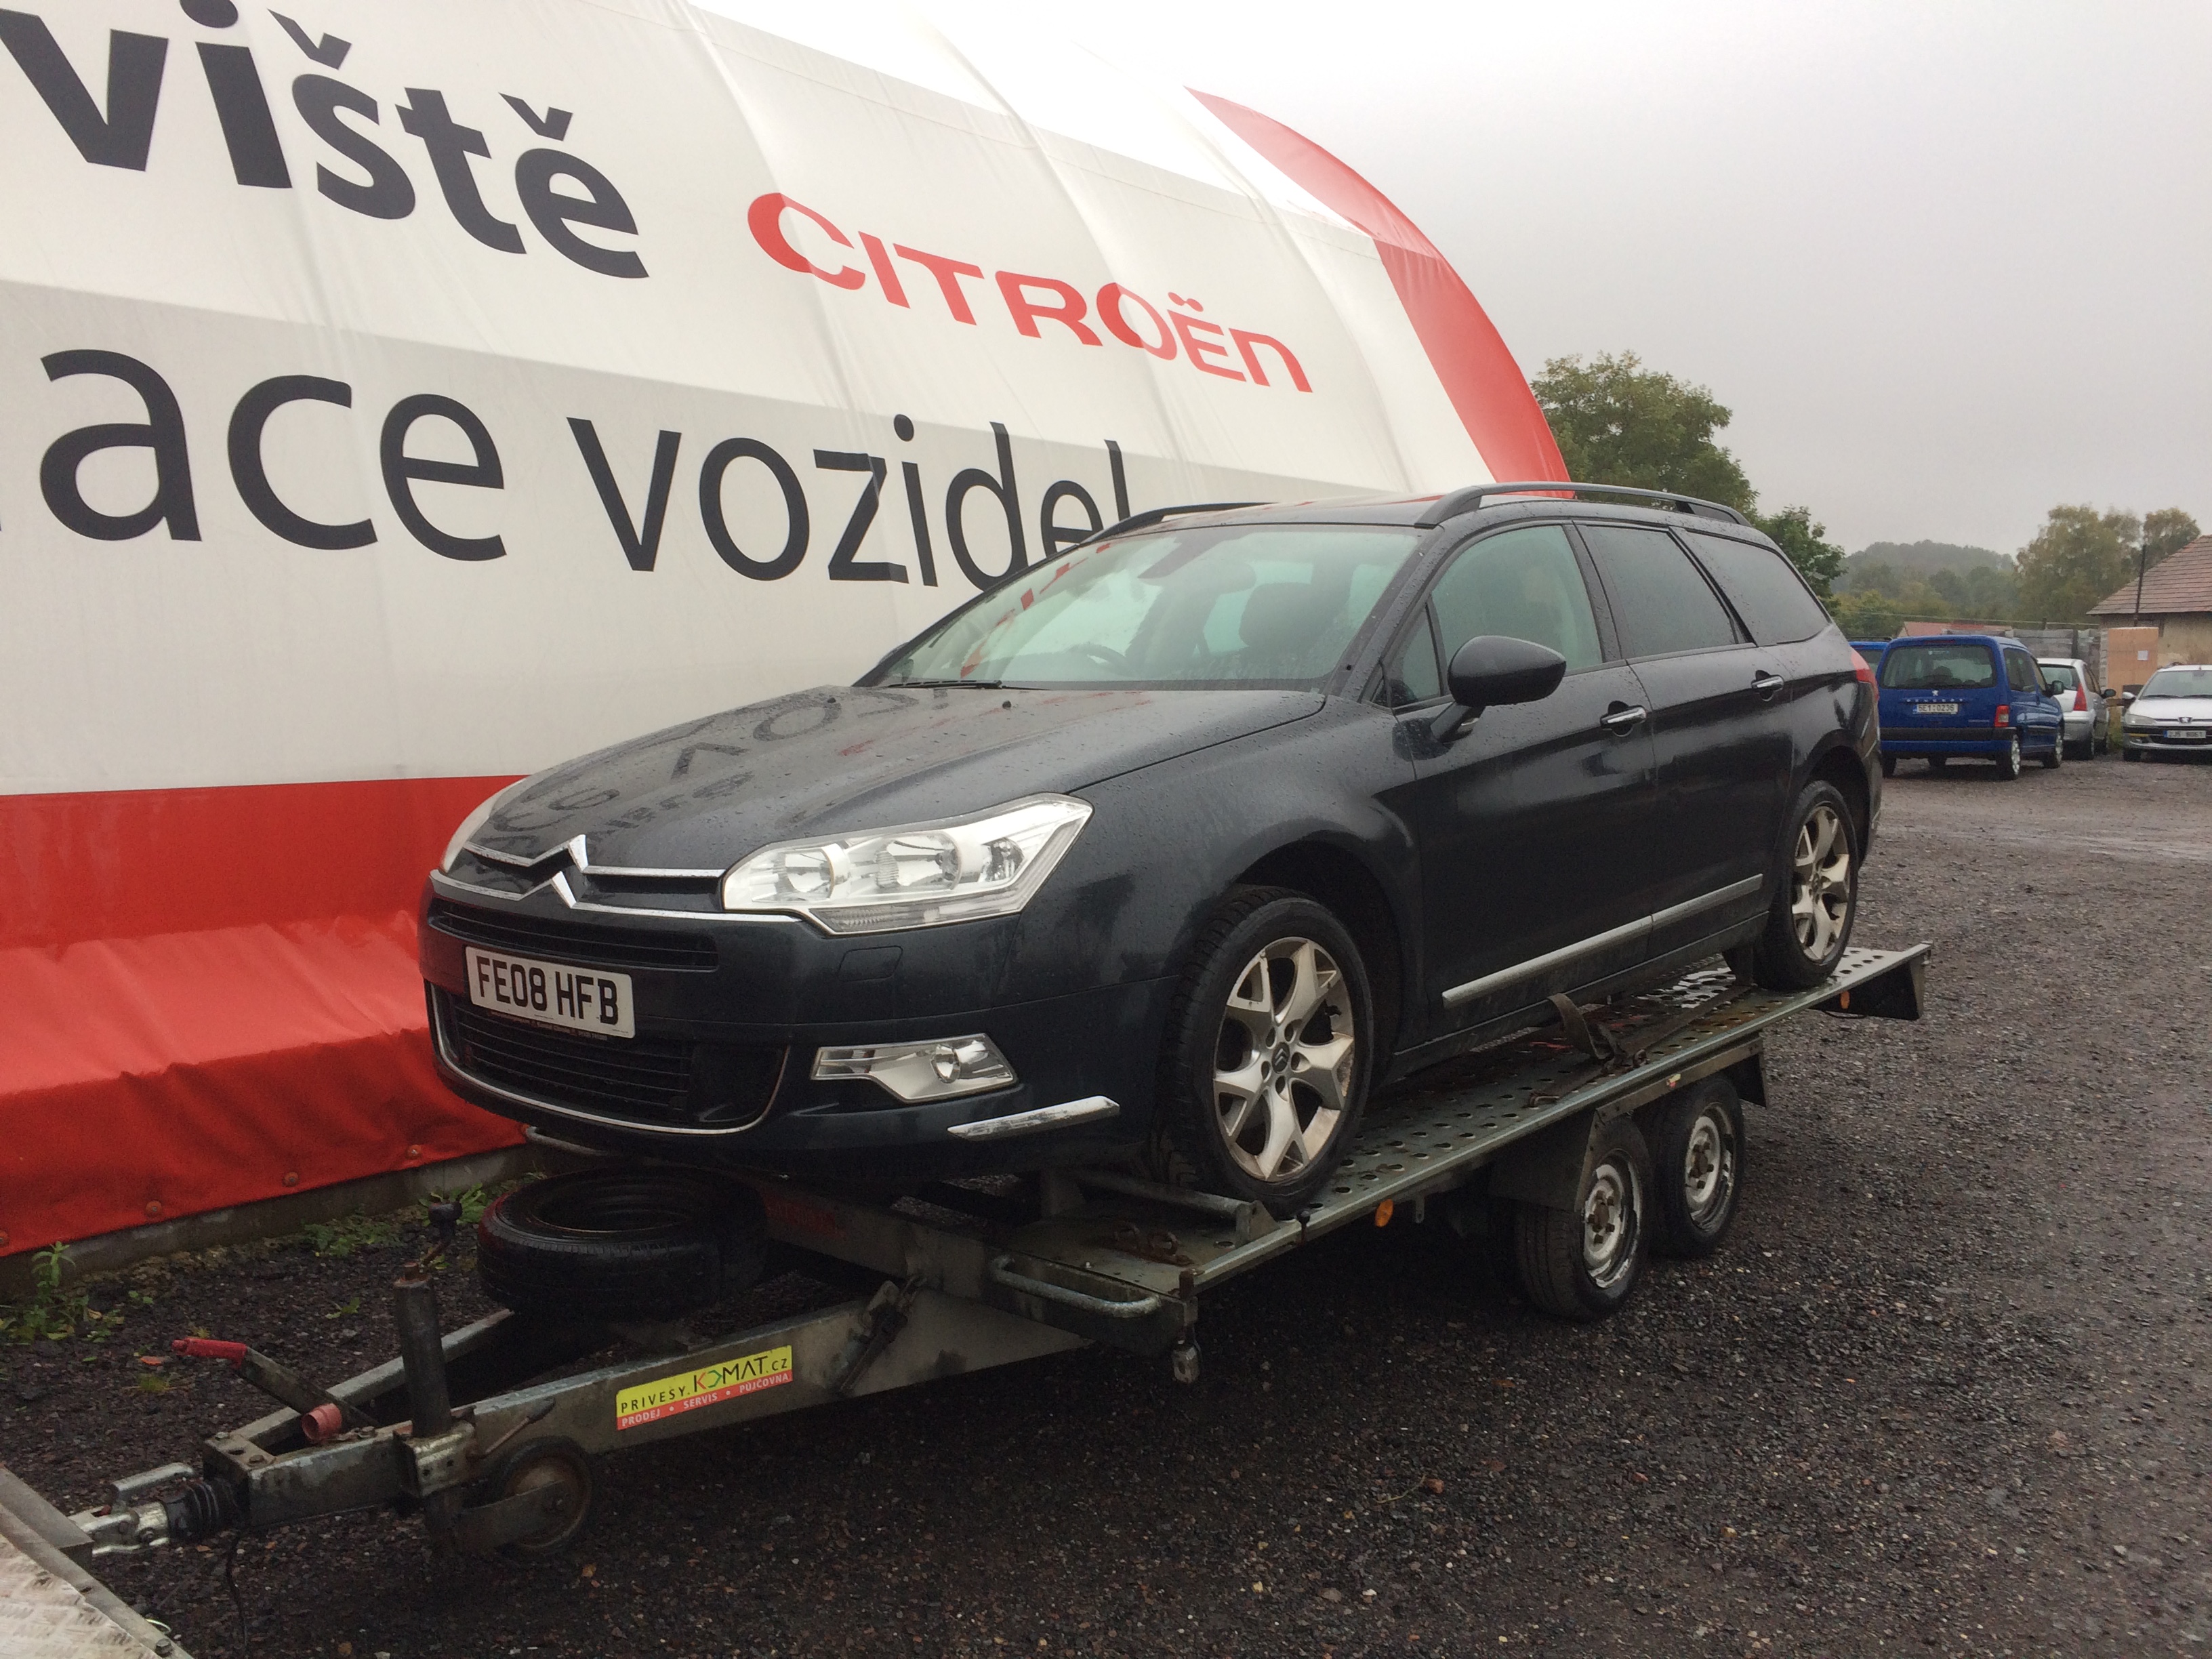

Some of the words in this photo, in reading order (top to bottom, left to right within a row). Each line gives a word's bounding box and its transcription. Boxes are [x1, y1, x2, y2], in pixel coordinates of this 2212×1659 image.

[0, 0, 649, 279] viště
[476, 956, 548, 1011] FE08
[555, 971, 619, 1025] HFB
[621, 1409, 661, 1427] PRODEJ
[683, 1392, 718, 1410] SERVIS
[739, 1372, 789, 1393] PŮJČOVNA
